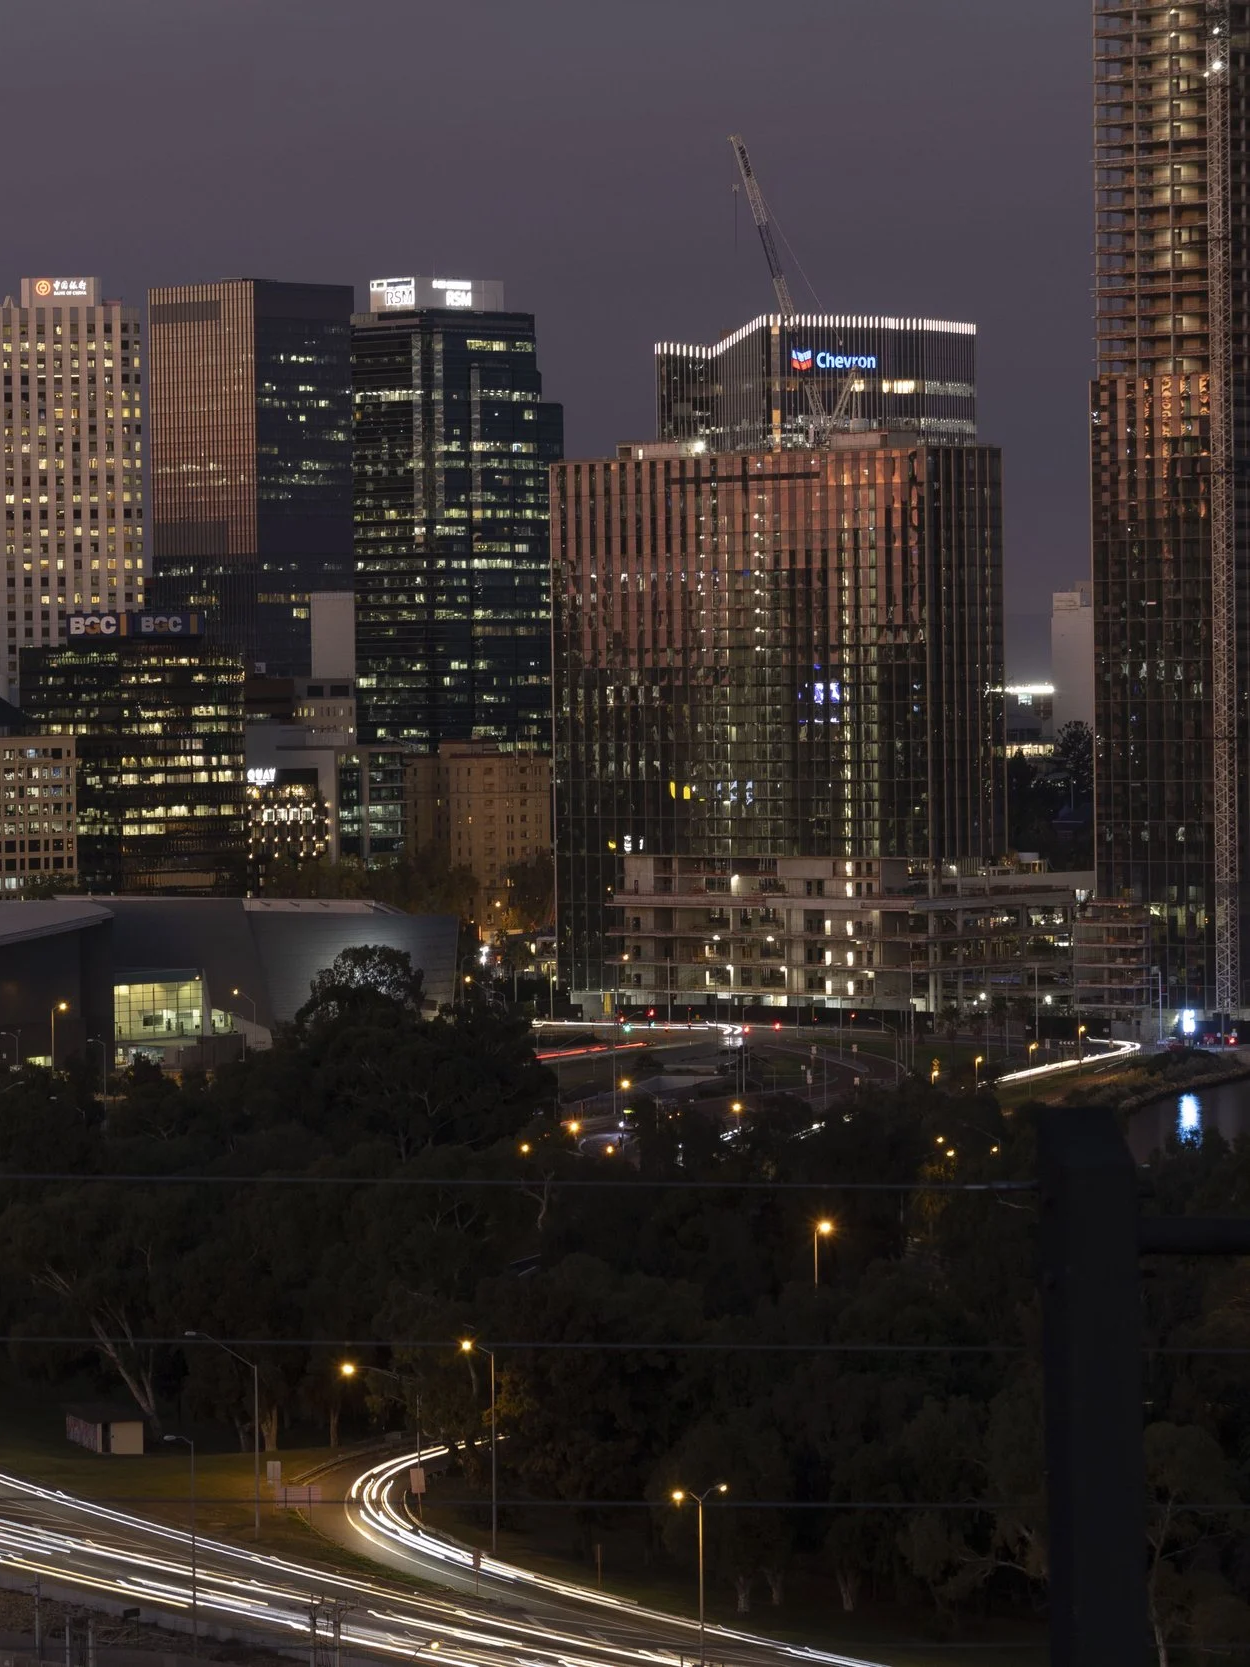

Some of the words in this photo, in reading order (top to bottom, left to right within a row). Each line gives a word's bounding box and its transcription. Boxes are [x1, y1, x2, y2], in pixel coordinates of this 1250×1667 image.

[386, 290, 413, 305] RSM
[445, 290, 472, 307] RSM
[816, 352, 876, 369] Chevron
[69, 616, 117, 635] BGC
[140, 616, 182, 633] BGC
[246, 767, 276, 781] QUAY
